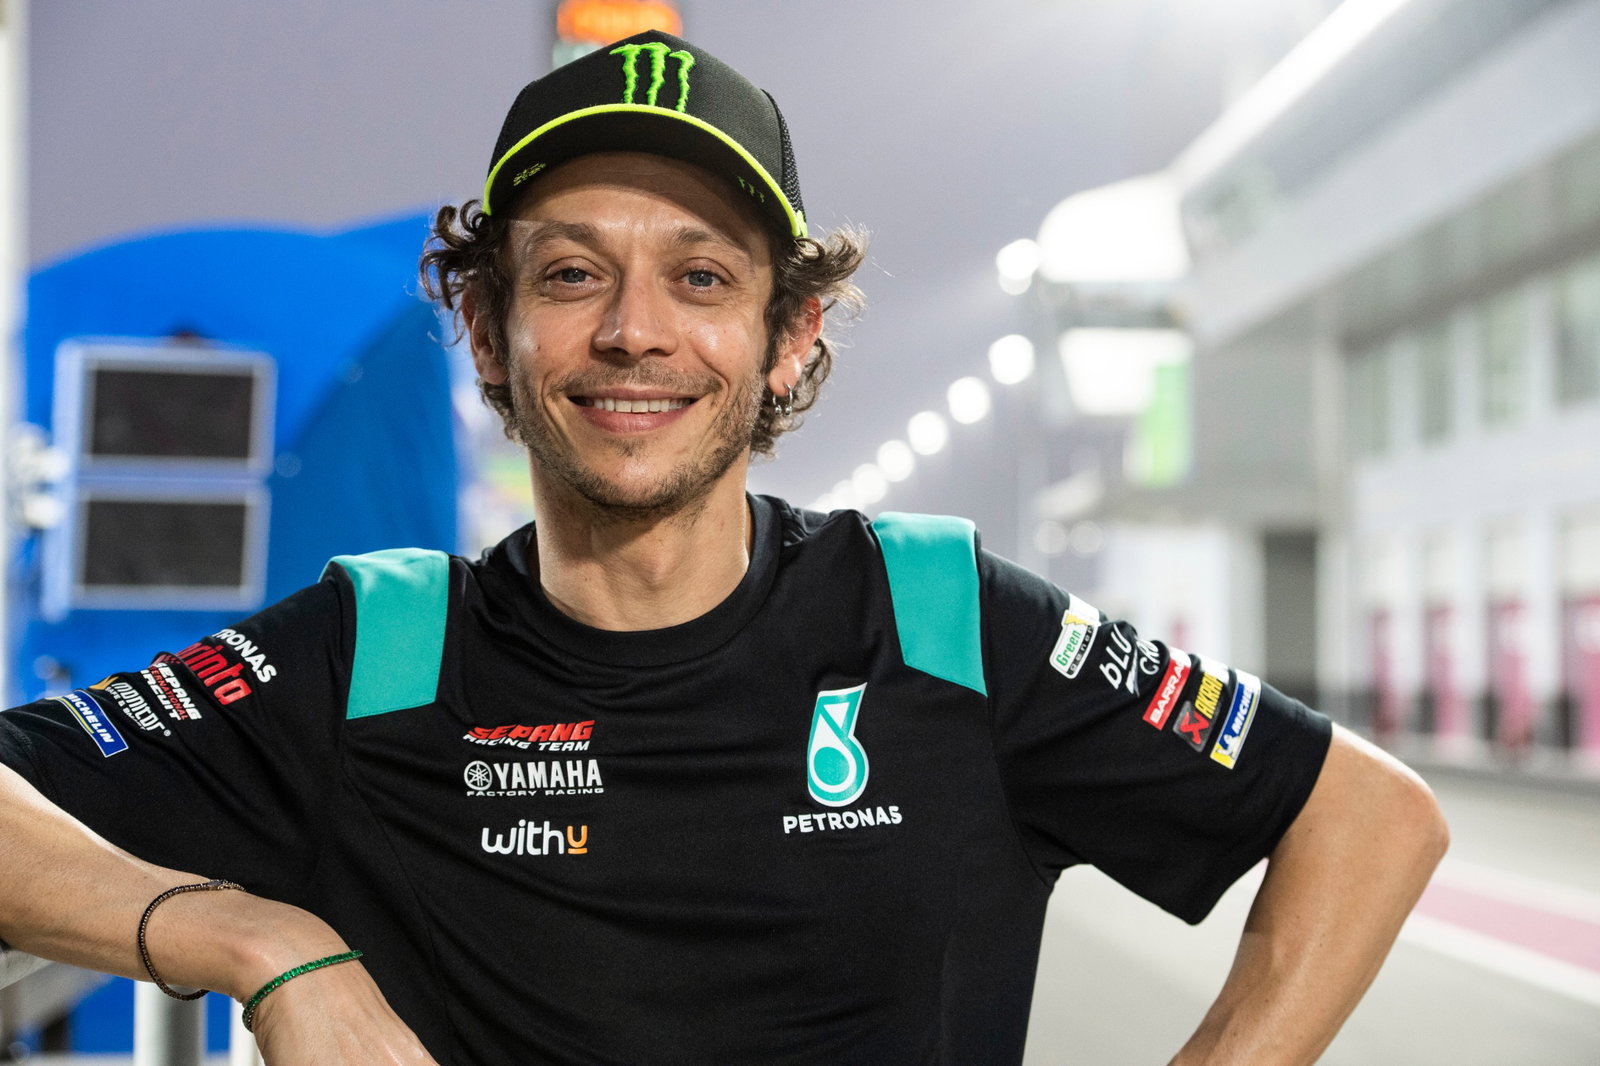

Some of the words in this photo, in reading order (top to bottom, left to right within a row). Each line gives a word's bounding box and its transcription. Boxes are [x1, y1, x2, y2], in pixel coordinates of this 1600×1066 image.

[468, 720, 595, 742] SEPANG
[463, 734, 531, 749] RACING
[539, 741, 590, 751] TEAM
[493, 759, 603, 789] YAMAHA
[545, 788, 604, 796] RACING
[783, 805, 903, 834] PETRONAS
